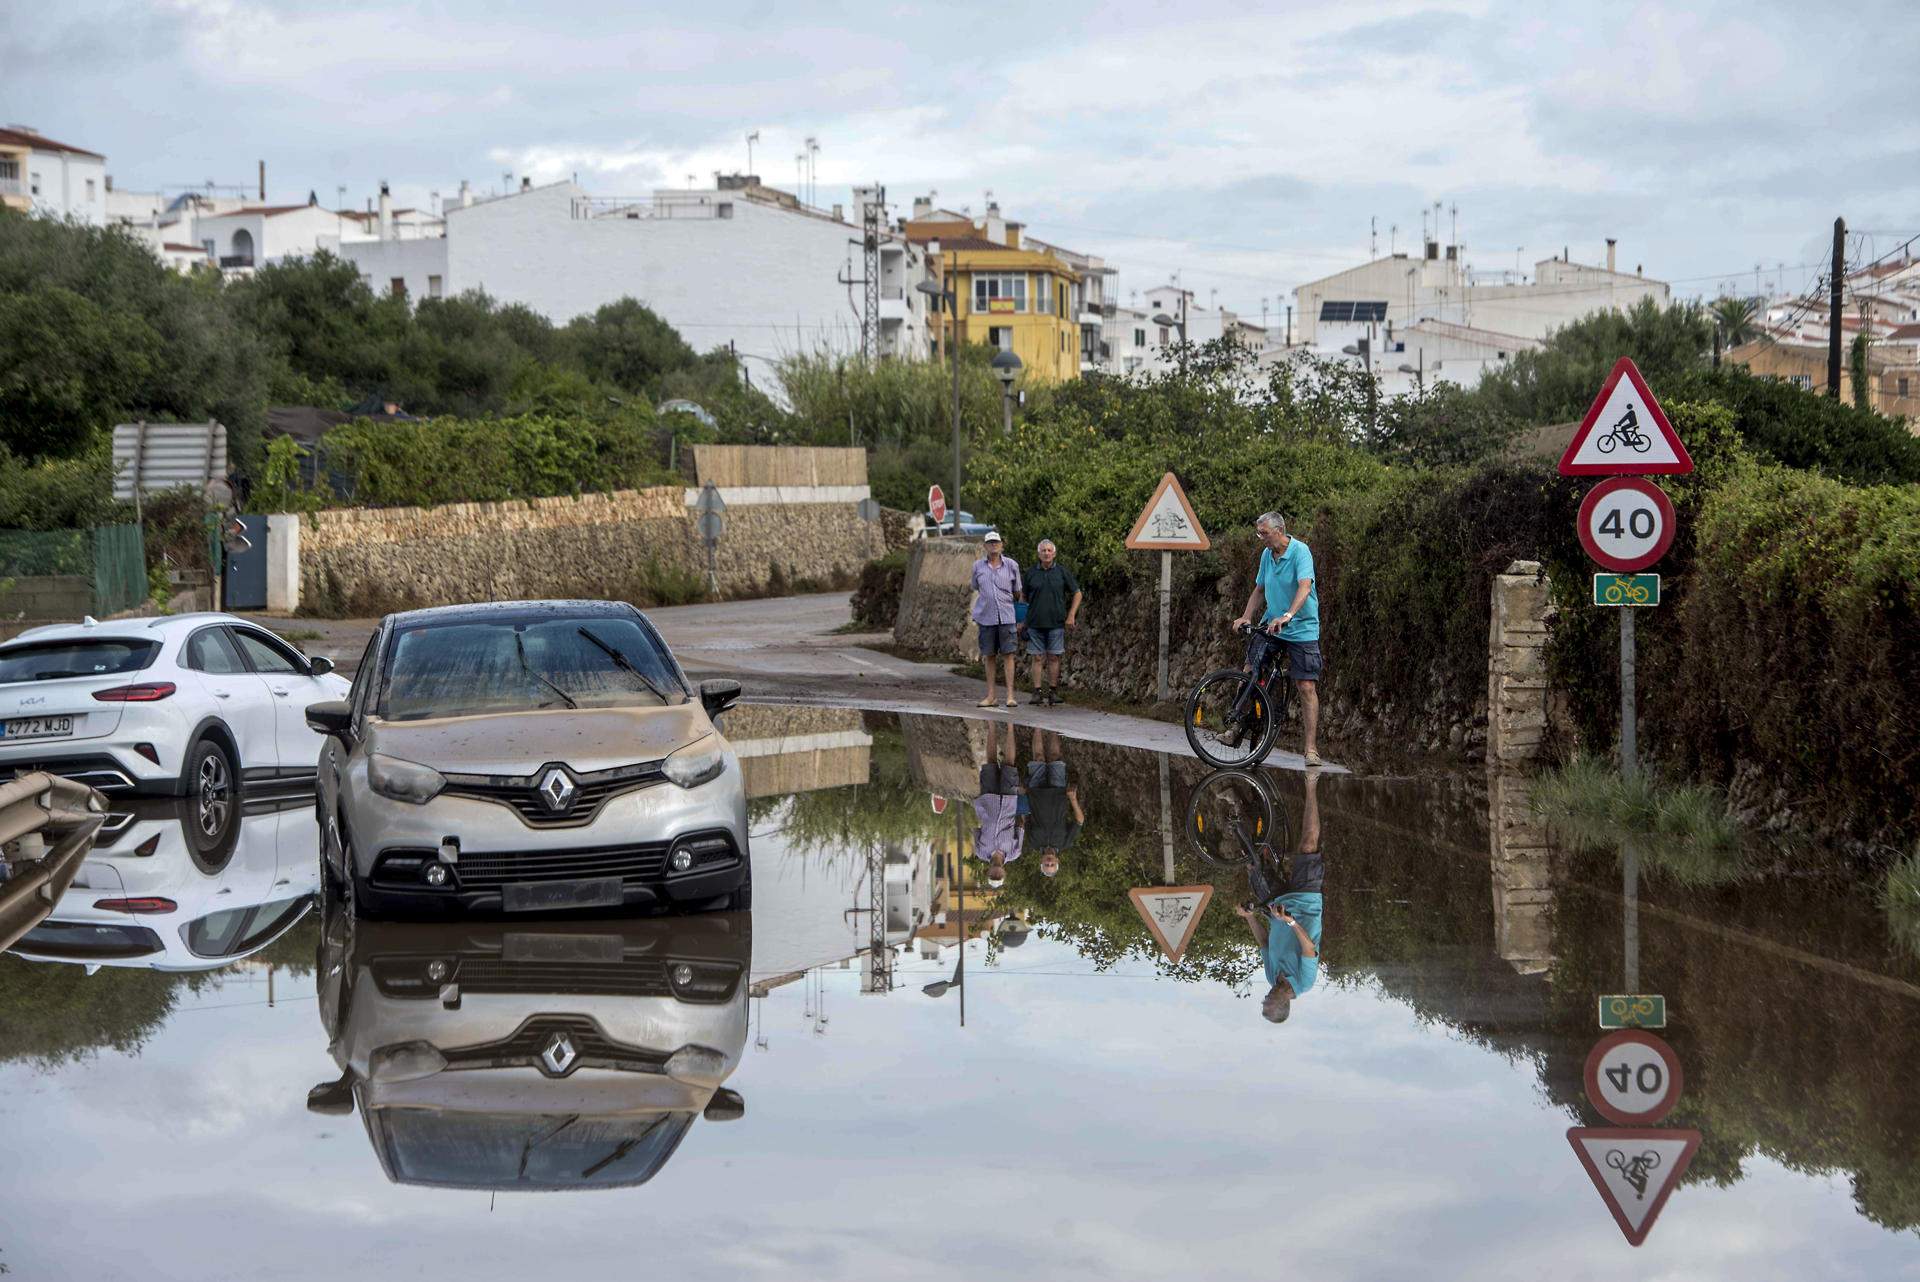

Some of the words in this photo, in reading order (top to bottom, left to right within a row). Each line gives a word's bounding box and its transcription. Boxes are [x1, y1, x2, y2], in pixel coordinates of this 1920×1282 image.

[1598, 508, 1655, 539] 40
[7, 720, 40, 734] 4772
[44, 718, 70, 732] MJD
